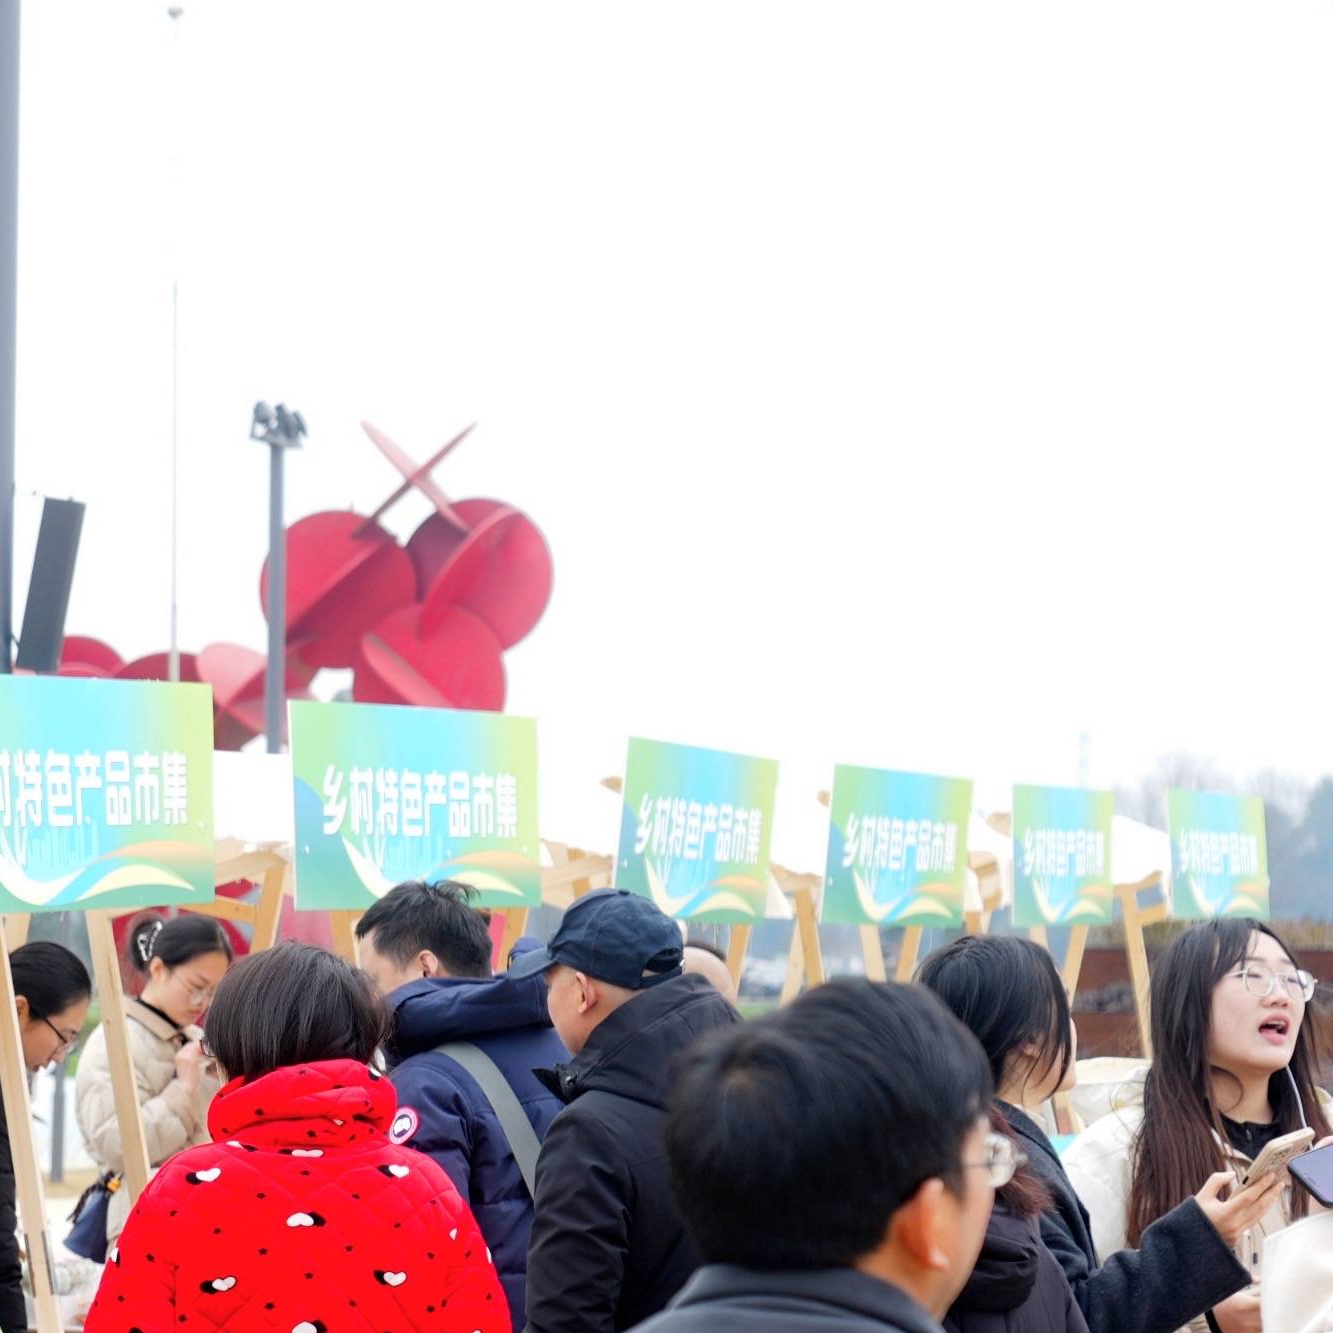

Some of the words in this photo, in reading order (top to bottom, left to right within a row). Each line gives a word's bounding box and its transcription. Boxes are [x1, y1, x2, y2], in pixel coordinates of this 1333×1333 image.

[321, 764, 518, 838] 乡村特色产品市集
[634, 792, 763, 865] 乡村特色产品市集
[842, 813, 959, 873] 乡村特色产品市集
